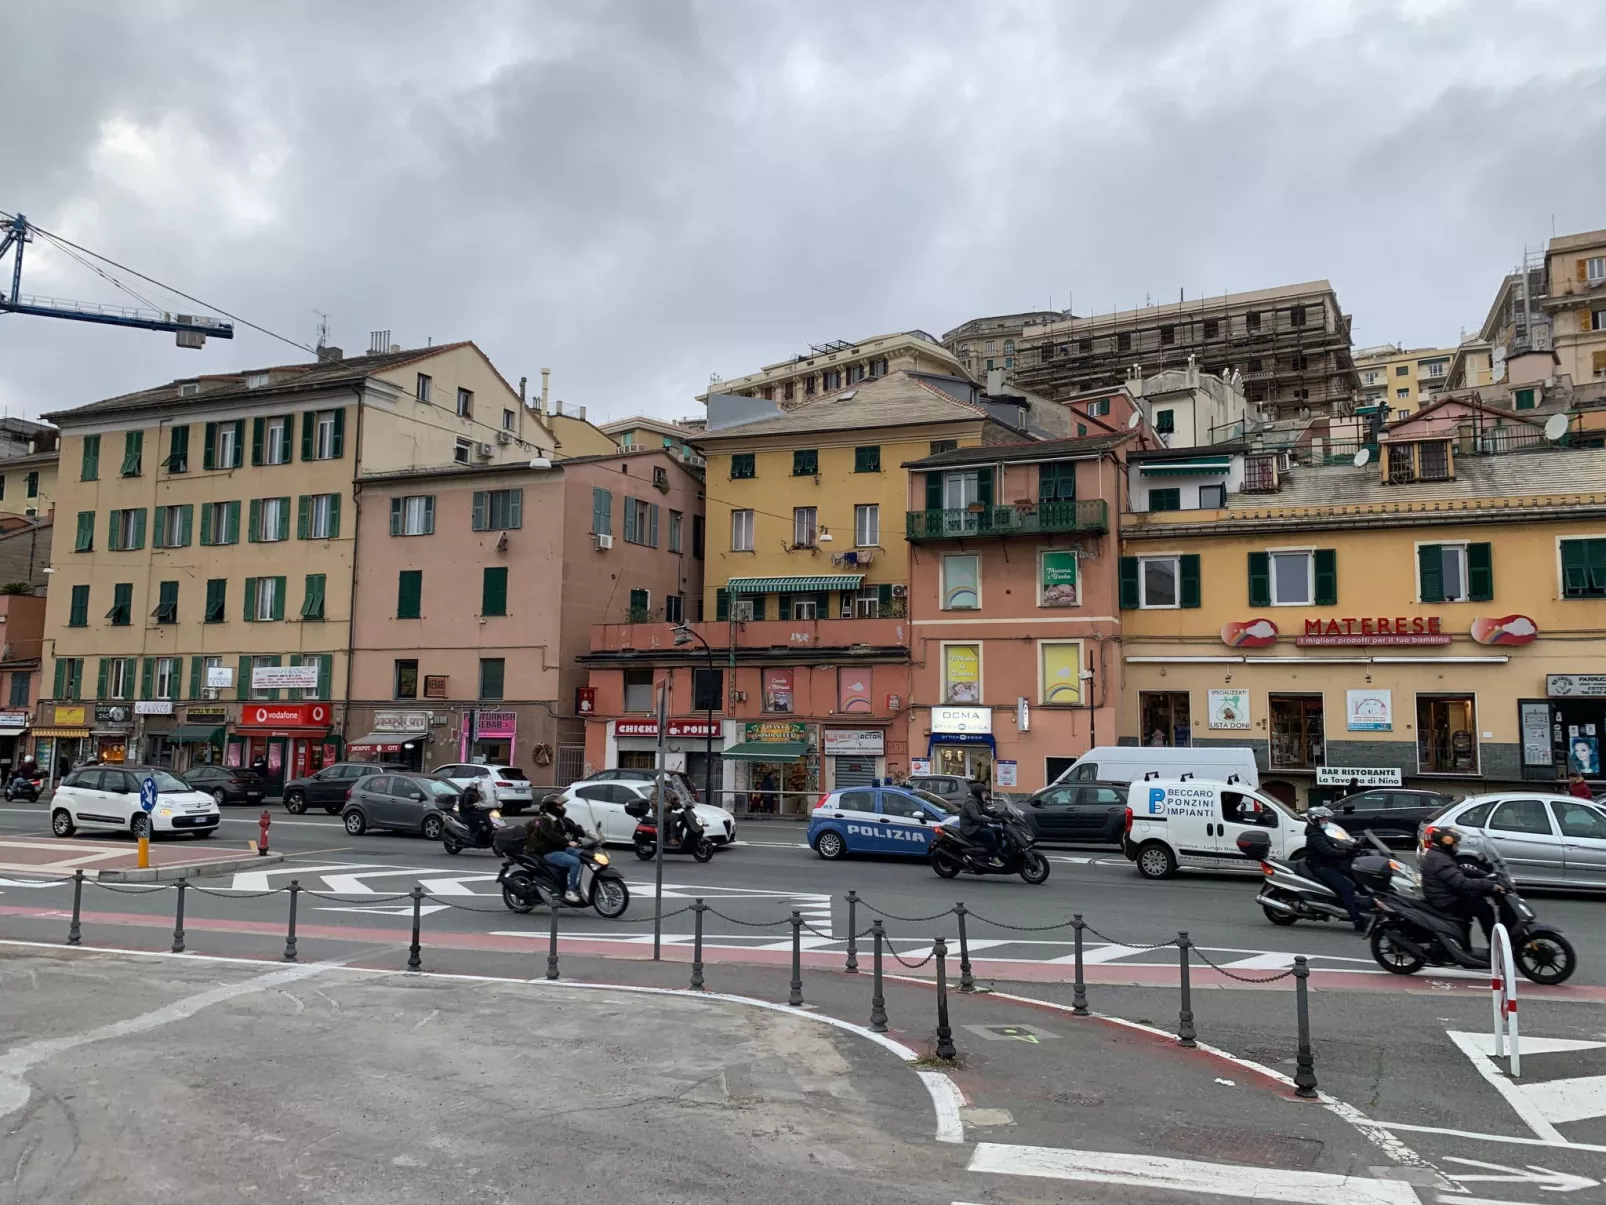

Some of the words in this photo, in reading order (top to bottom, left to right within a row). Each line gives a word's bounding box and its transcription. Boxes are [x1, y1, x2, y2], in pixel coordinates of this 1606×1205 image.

[1304, 616, 1441, 636] MATERESE
[1306, 637, 1336, 645] migliori
[1338, 637, 1370, 645] prodotti
[268, 710, 299, 719] vodafone
[618, 725, 659, 733] CHICKE
[1367, 776, 1376, 784] di
[1167, 788, 1214, 798] BECCARO
[1167, 798, 1214, 807] PONZINI
[1167, 807, 1214, 817] IMPIANTI
[847, 824, 926, 843] POLIZIA
